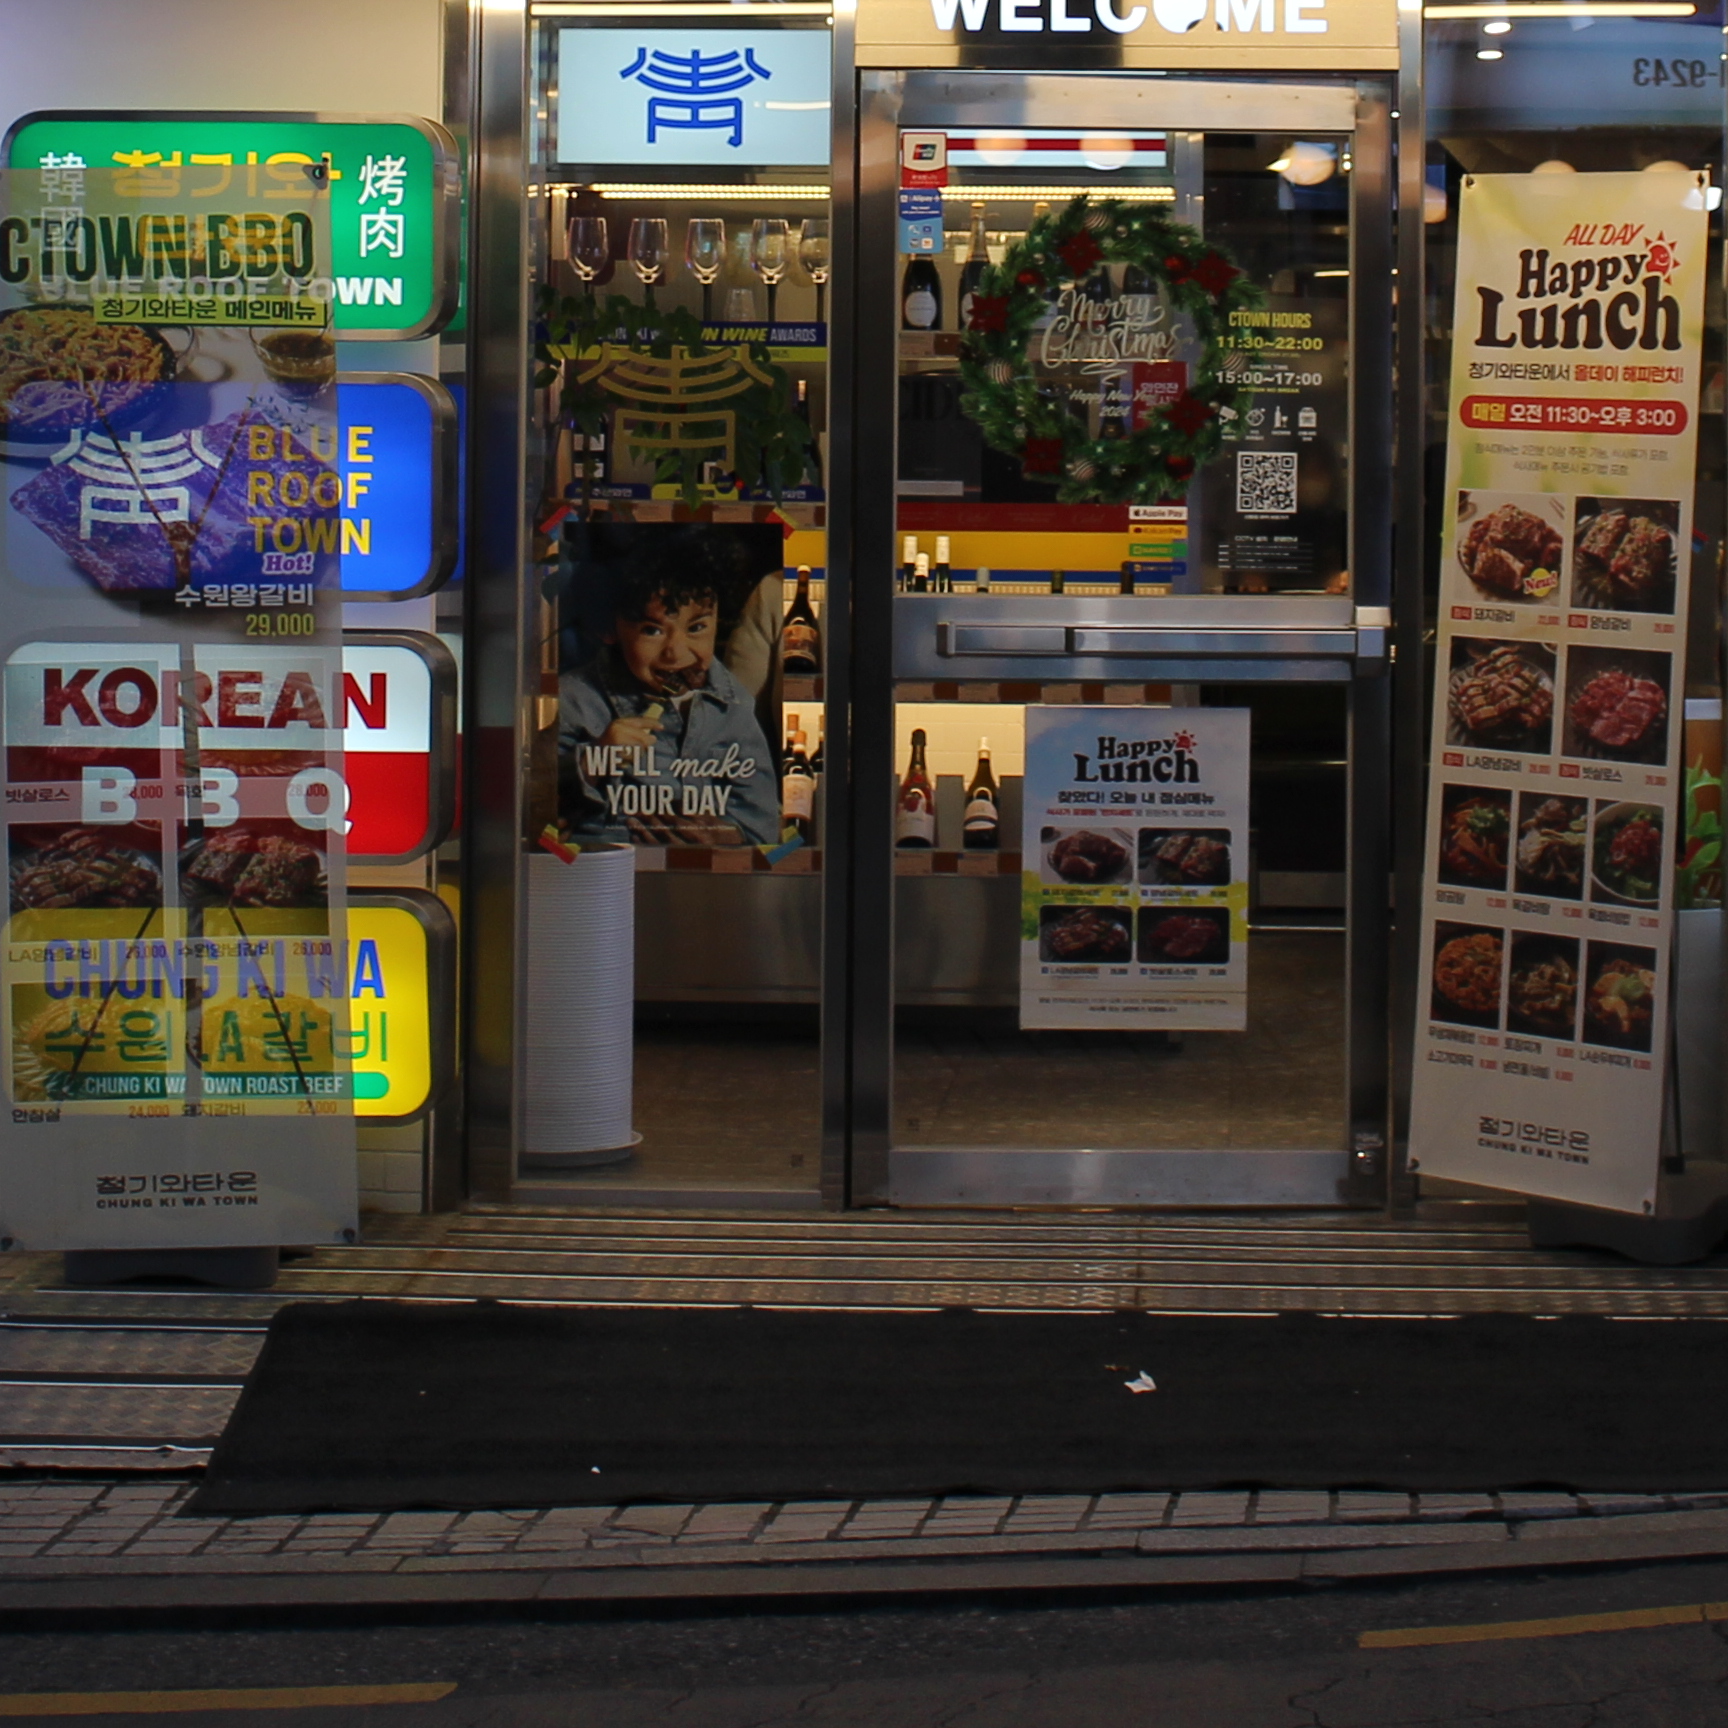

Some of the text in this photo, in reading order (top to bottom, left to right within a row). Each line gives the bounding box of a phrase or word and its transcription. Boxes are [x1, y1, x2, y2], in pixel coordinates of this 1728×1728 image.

[111, 149, 343, 199] 청기와
[357, 154, 408, 259] 烤肉
[1562, 223, 1646, 247] ALL DAY
[1516, 248, 1649, 300] Happy
[281, 276, 403, 306] TOWN
[101, 297, 317, 321] 청기와타운 메인메뉴
[1057, 288, 1166, 337] Merry
[1228, 310, 1313, 330] CTOWN HOURS
[1474, 274, 1683, 351] Lunch
[721, 328, 767, 342] WINE
[769, 328, 817, 343] AWARDS
[1041, 315, 1194, 369] Christmas
[1216, 335, 1324, 351] 11:30~22:00
[1215, 371, 1324, 387] 15:00~17:00
[1468, 362, 1685, 385] 청기와타운에서 올데이 해피런치!
[1471, 402, 1676, 427] 매일 오전 11:30~오후 3:00
[248, 425, 375, 463] BLUE
[245, 471, 374, 510] ROOF
[246, 517, 372, 557] TOWN
[262, 552, 315, 576] Hot!
[174, 583, 315, 608] 수원왕갈비
[245, 612, 316, 638] 29,000
[42, 666, 388, 731] KOREAN
[668, 742, 757, 780] make
[1097, 736, 1178, 761] Happy
[1073, 749, 1201, 784] Lunch
[605, 783, 733, 818] YOUR DAY
[1057, 790, 1215, 806] 찾았다! 오늘 내 점심메뉴
[43, 938, 386, 1001] CHUNG KI WA
[85, 1075, 140, 1095] CHUNG
[144, 1075, 162, 1094] KI
[201, 1074, 245, 1094] OWN
[247, 1074, 302, 1094] ROAST
[1479, 1115, 1591, 1152] 청기와타운
[96, 1172, 258, 1195] 청기와타운
[96, 1195, 259, 1210] CHUNG KI WA TOWN
